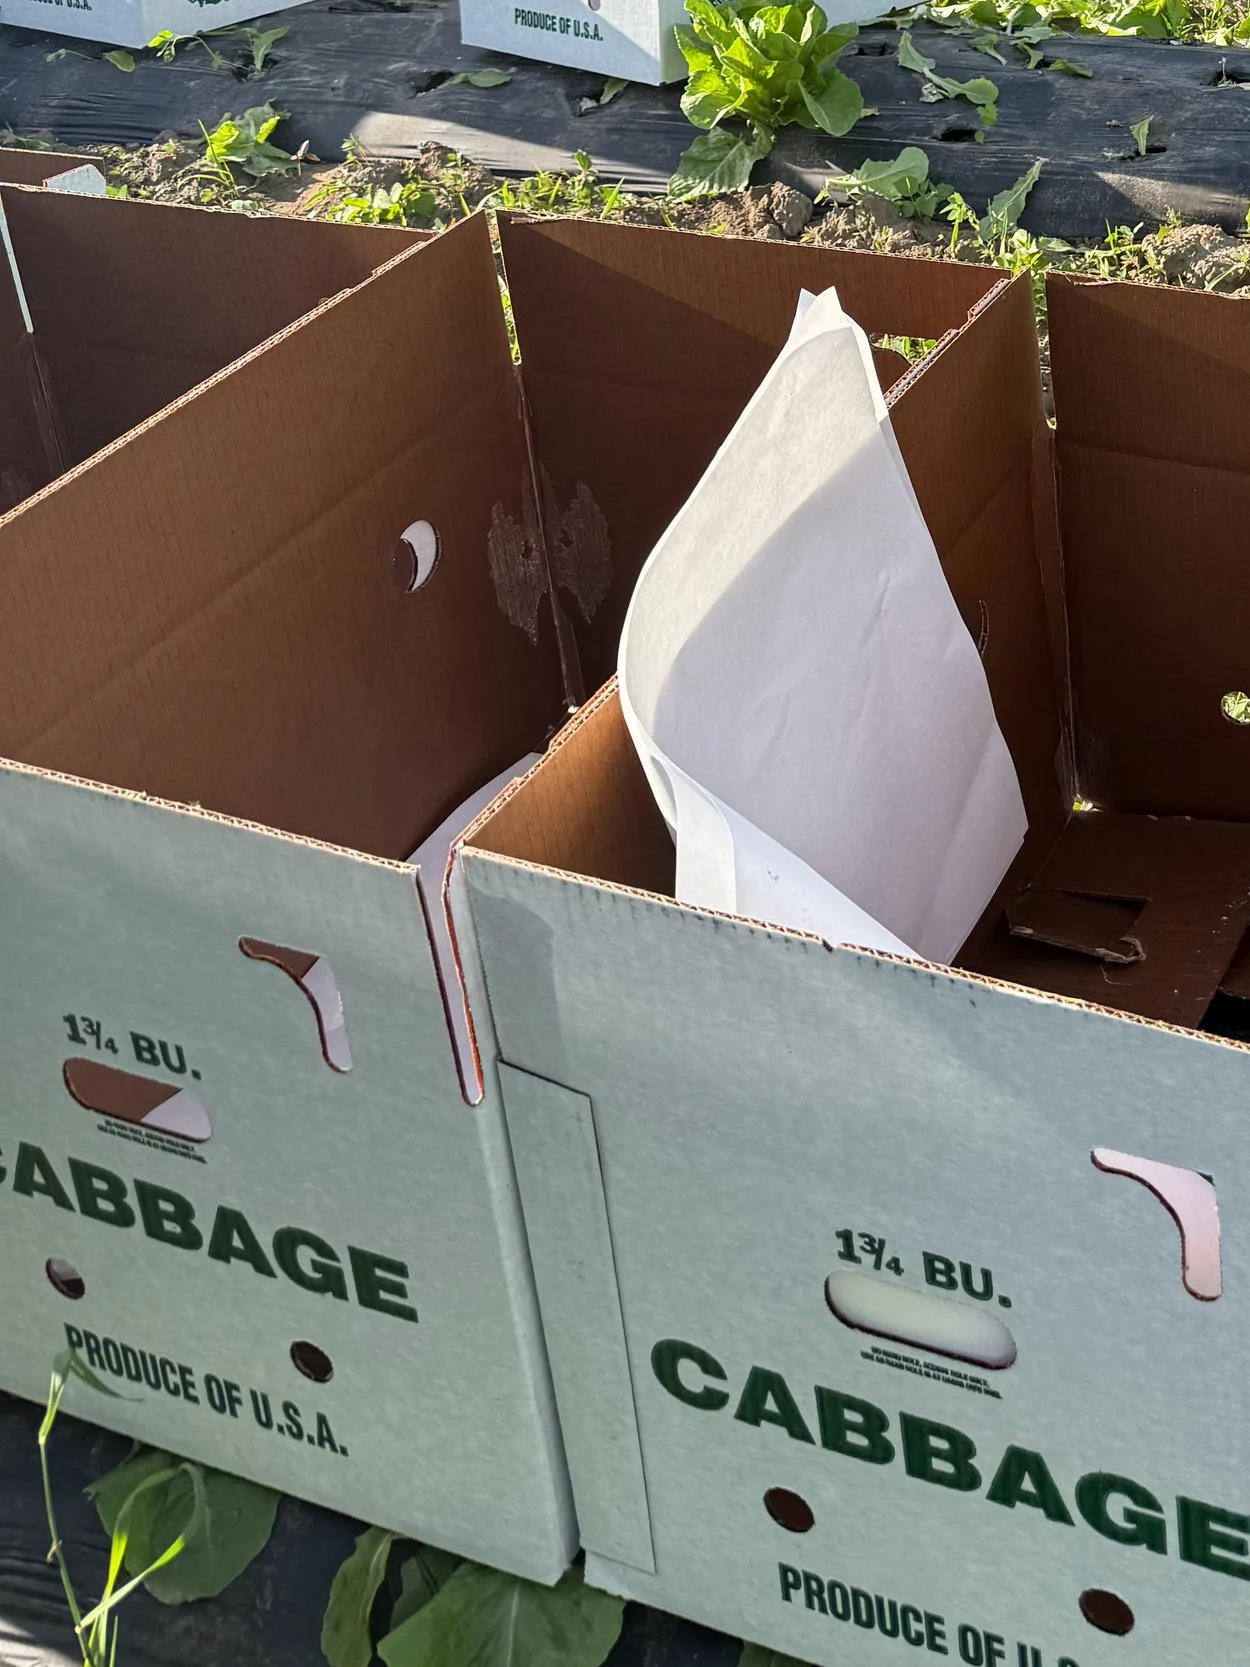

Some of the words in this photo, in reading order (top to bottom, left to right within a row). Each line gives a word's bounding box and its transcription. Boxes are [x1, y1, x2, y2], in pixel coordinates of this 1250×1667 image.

[514, 8, 556, 32] PRODUCE
[559, 17, 571, 35] OF
[573, 20, 604, 41] U.S.A.
[130, 1030, 202, 1080] BU.
[0, 1141, 419, 1324] ABBAGE
[922, 1249, 1012, 1308] BU.
[64, 1321, 199, 1405] PRODUCE
[206, 1373, 243, 1420] OF
[252, 1391, 350, 1458] U.S.A.
[778, 1561, 949, 1656] PRODUCE
[958, 1623, 1006, 1667] OF
